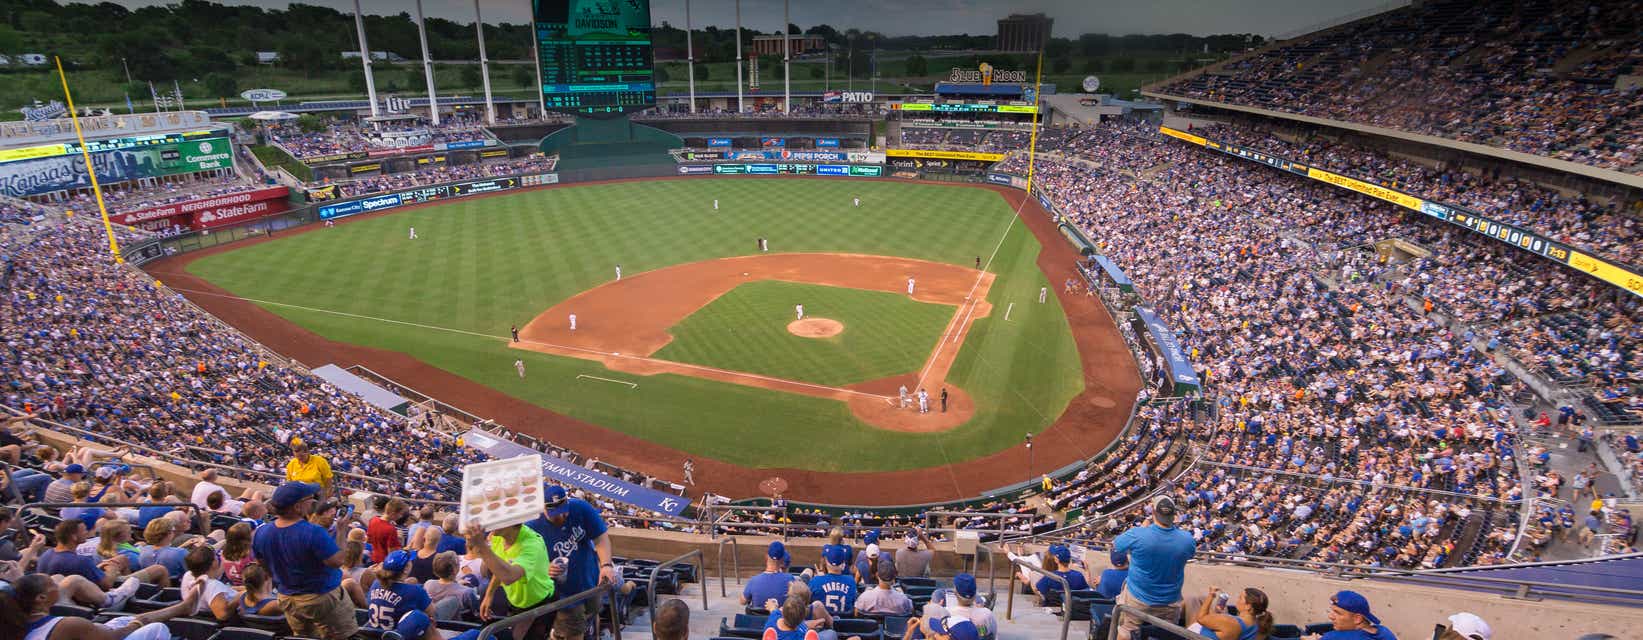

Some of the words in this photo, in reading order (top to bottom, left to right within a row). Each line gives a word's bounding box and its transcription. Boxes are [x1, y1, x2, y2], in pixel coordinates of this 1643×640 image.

[575, 19, 618, 29] DAVIDSON
[951, 68, 980, 82] BLUE
[993, 69, 1026, 82] MOON
[842, 92, 873, 102] PATIO
[385, 96, 411, 113] Lite
[186, 152, 229, 163] Commerce
[793, 152, 813, 160] PEPSI
[200, 160, 221, 169] Bank
[892, 160, 913, 168] Sprint
[1, 164, 71, 197] Kansas
[72, 153, 110, 177] City
[181, 193, 251, 213] NEIGHBORHOOD
[362, 197, 398, 210] Spectrum
[1465, 217, 1474, 226] 4
[1489, 224, 1498, 235] 0
[1511, 232, 1520, 243] 0
[575, 472, 630, 497] STADIUM
[658, 497, 678, 512] KC
[553, 526, 587, 557] Royals
[822, 581, 850, 594] VARGAS
[370, 588, 402, 605] HOSMER
[825, 595, 847, 612] 51
[368, 602, 396, 631] 35
